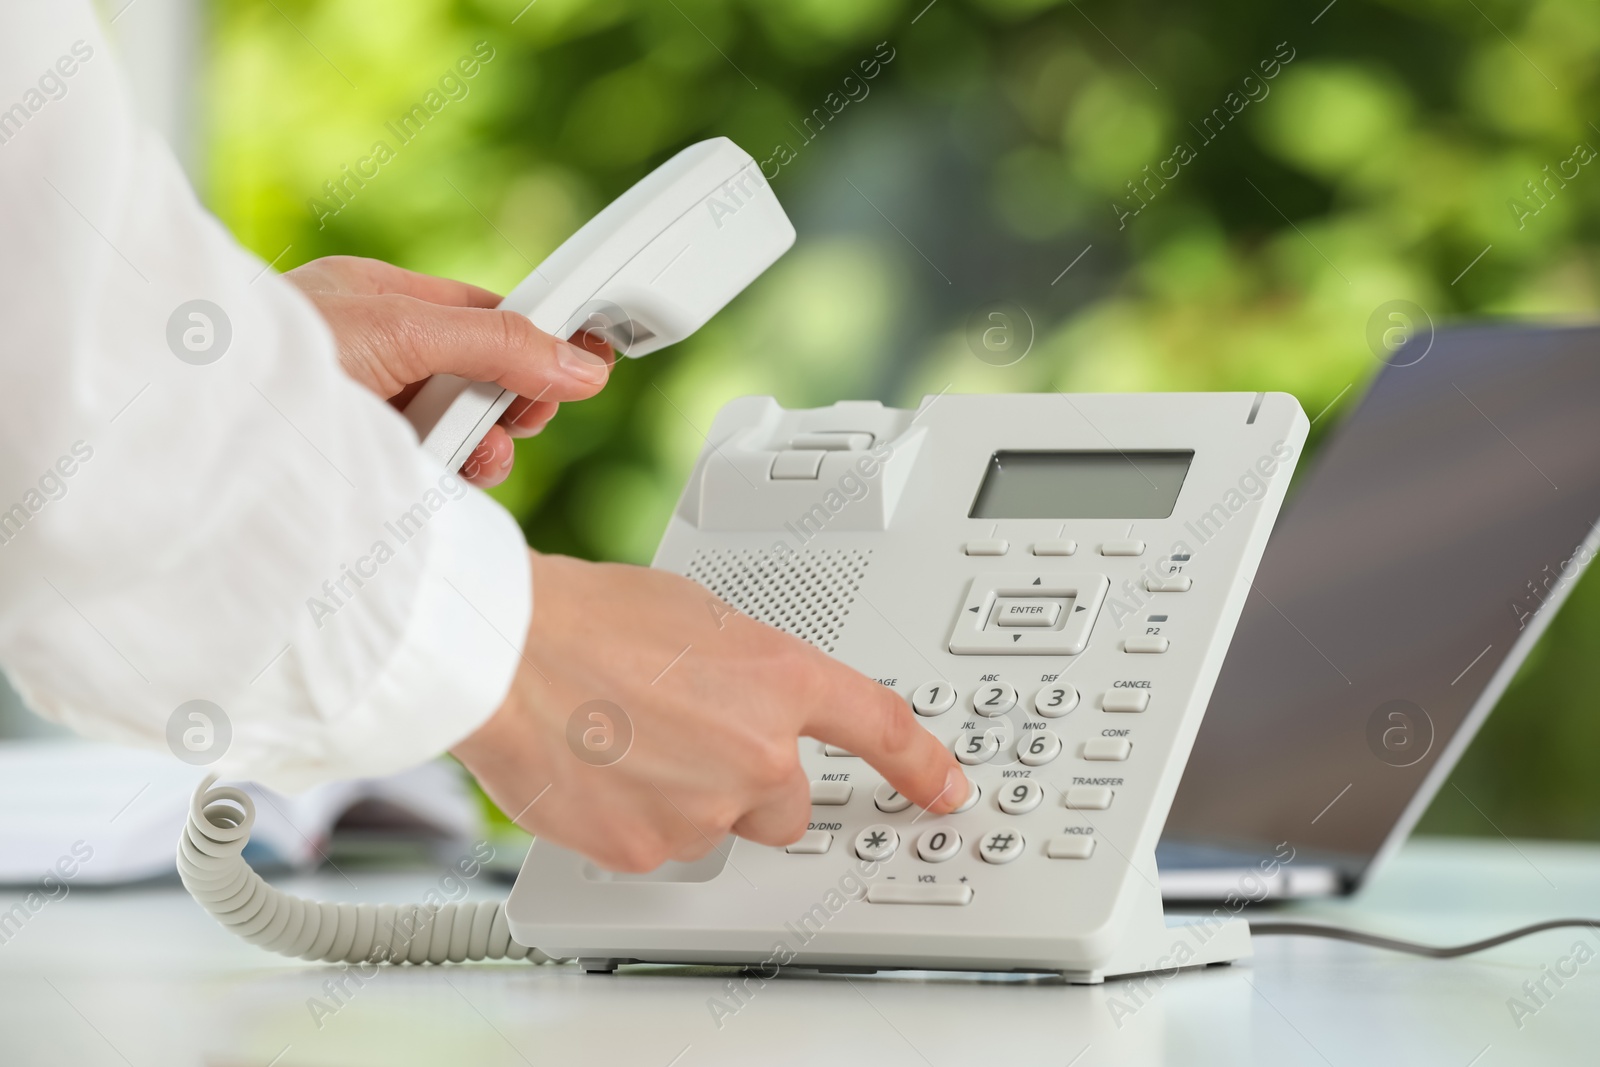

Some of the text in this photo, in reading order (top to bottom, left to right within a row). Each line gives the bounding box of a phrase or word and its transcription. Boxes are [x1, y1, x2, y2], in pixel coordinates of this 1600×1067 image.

[1169, 566, 1183, 574] P1
[1009, 606, 1044, 614] ENTER
[1145, 627, 1161, 636] P2
[979, 674, 1001, 682] ABC
[1040, 674, 1060, 682] DEF
[1113, 680, 1152, 689] CANCEL
[929, 687, 940, 704] 1
[984, 688, 1003, 706] 2
[1047, 689, 1065, 706] 3
[961, 721, 976, 730] JKL
[1022, 722, 1047, 730] MNO
[1101, 729, 1130, 737] CONF
[966, 736, 984, 754] 5
[1029, 736, 1046, 754] 6
[821, 773, 850, 782] MUTE
[1002, 770, 1032, 778] WXYZ
[1072, 777, 1124, 786] TRANSFER
[1010, 785, 1028, 803] 9
[1064, 827, 1094, 835] HOLD
[929, 832, 947, 851] 0
[918, 875, 937, 883] VOL
